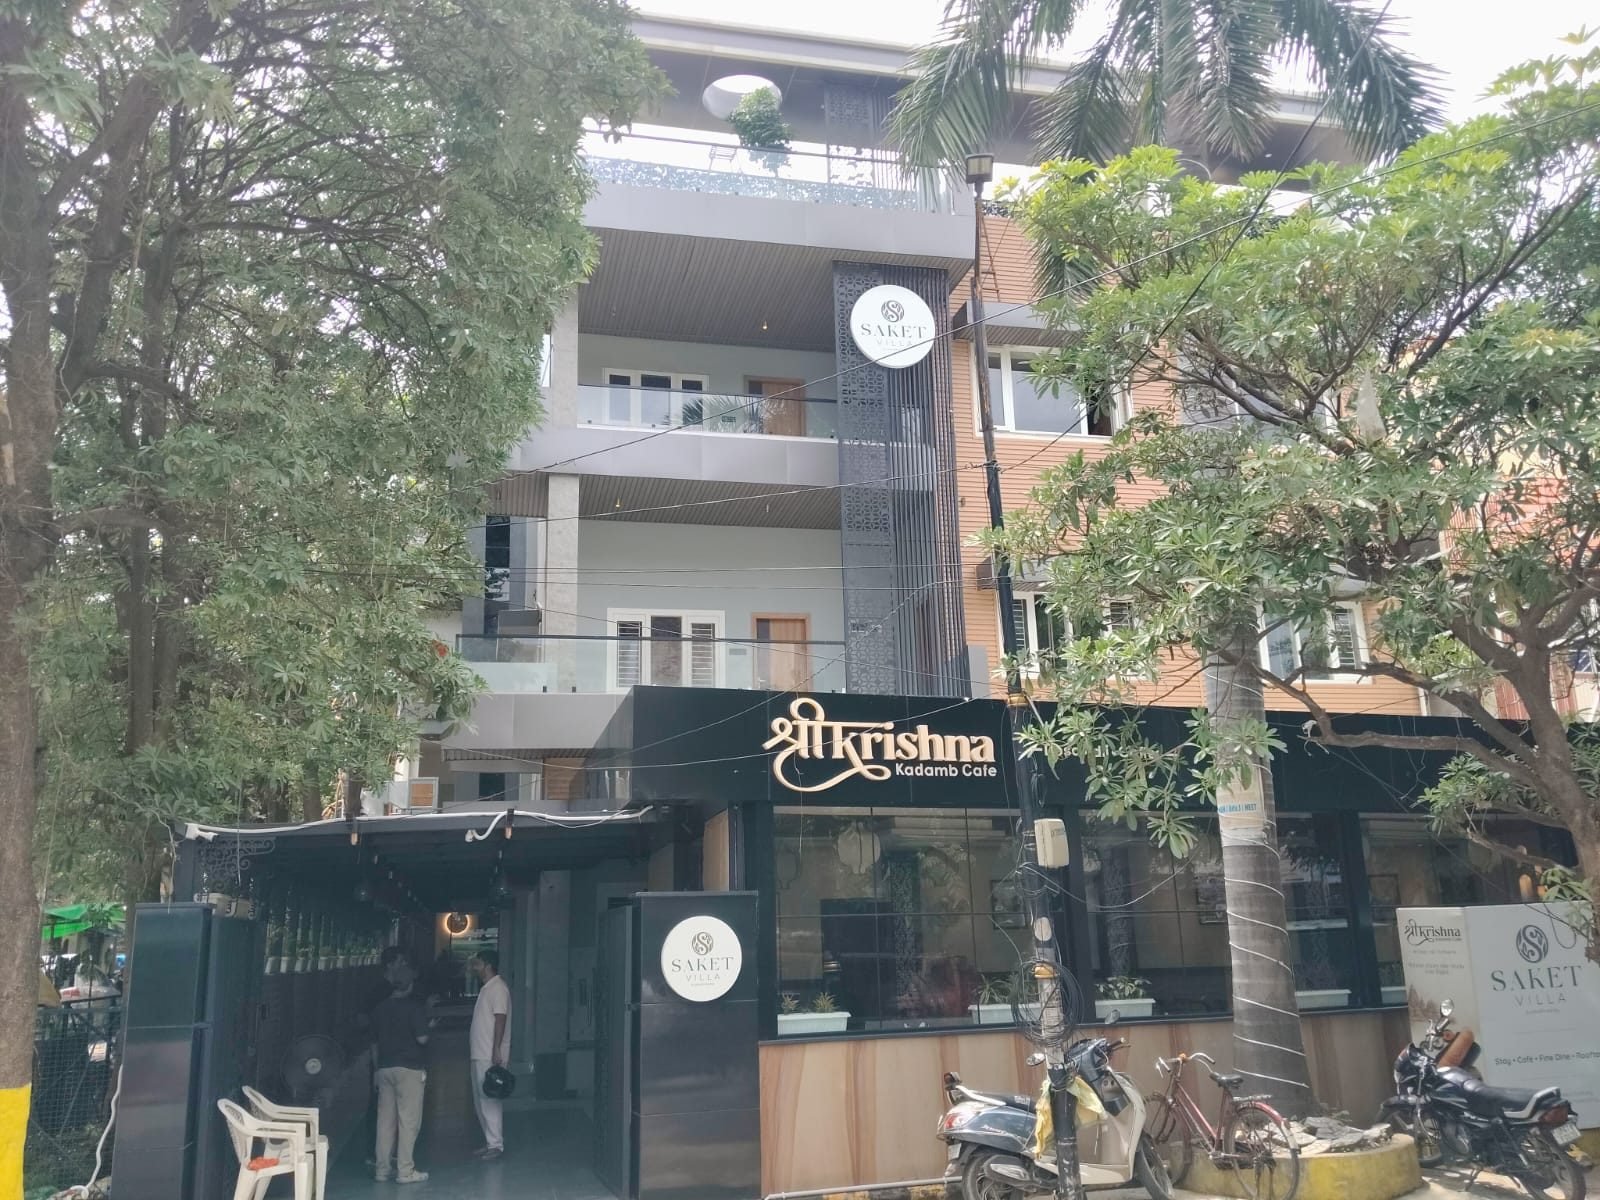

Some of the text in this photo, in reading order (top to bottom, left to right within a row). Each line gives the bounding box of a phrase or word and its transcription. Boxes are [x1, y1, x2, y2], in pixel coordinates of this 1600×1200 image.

[861, 323, 927, 339] SAKET
[830, 720, 996, 763] krishna
[895, 762, 997, 778] Kadamb Cafe
[671, 956, 734, 973] SAKET
[686, 973, 721, 982] VILLA
[1491, 965, 1582, 992] SAKET
[1514, 993, 1567, 1007] VILLA
